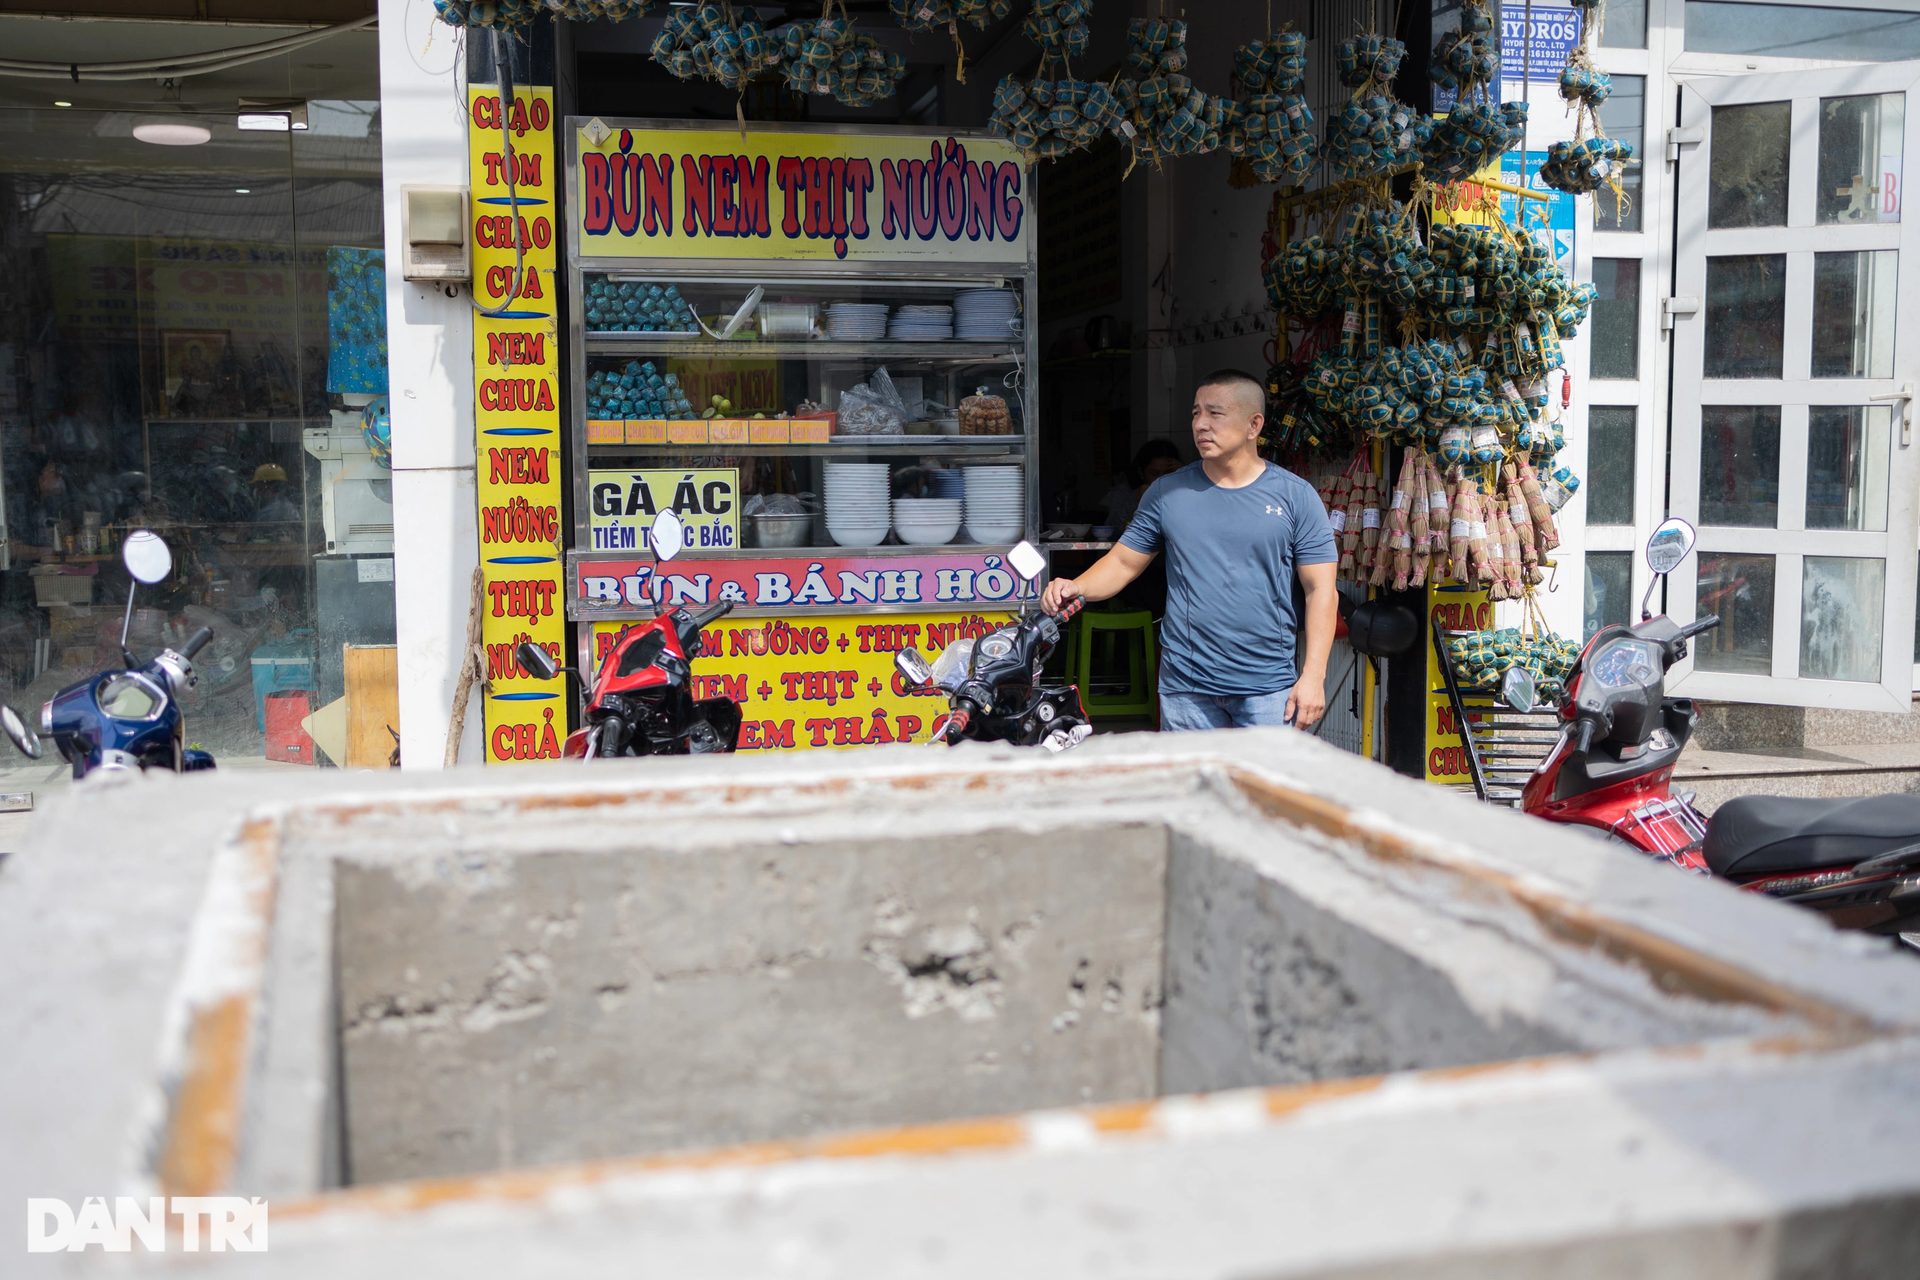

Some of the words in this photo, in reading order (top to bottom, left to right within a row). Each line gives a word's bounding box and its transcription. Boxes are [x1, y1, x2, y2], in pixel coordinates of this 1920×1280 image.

[1504, 40, 1534, 48] HYDRS
[472, 95, 550, 137] CHẠO
[482, 147, 543, 187] TÔM
[583, 128, 674, 237] BÚN
[681, 153, 771, 239] NEM
[777, 156, 874, 259] THỊT
[880, 137, 1024, 243] NƯỚNG
[475, 214, 552, 254] CHẠO
[486, 265, 543, 300] CUA
[487, 332, 545, 367] NEM
[479, 378, 556, 412] CHUA
[603, 425, 622, 438] CHUA
[628, 426, 647, 442] CHẠO
[649, 422, 663, 439] TÔM
[670, 426, 689, 442] CHẠO
[691, 426, 705, 438] CUA
[751, 426, 765, 442] THỊT
[792, 427, 805, 440] NEM
[489, 446, 550, 485] NEM
[593, 474, 657, 516] GÀ
[672, 474, 732, 516] ÁC
[483, 496, 559, 544] NƯỚNG
[593, 519, 635, 549] TIỀM
[700, 518, 733, 547] BẮC
[583, 566, 713, 607] BÚN
[718, 581, 748, 603] &
[754, 562, 922, 605] BÁNH
[934, 554, 1038, 605] HỎI
[487, 579, 557, 626] THỊT
[729, 620, 829, 657] NƯỚNG
[856, 623, 921, 656] THỊT
[780, 669, 859, 706] THỊT
[491, 707, 561, 761] CHẢ
[738, 718, 796, 750] EM
